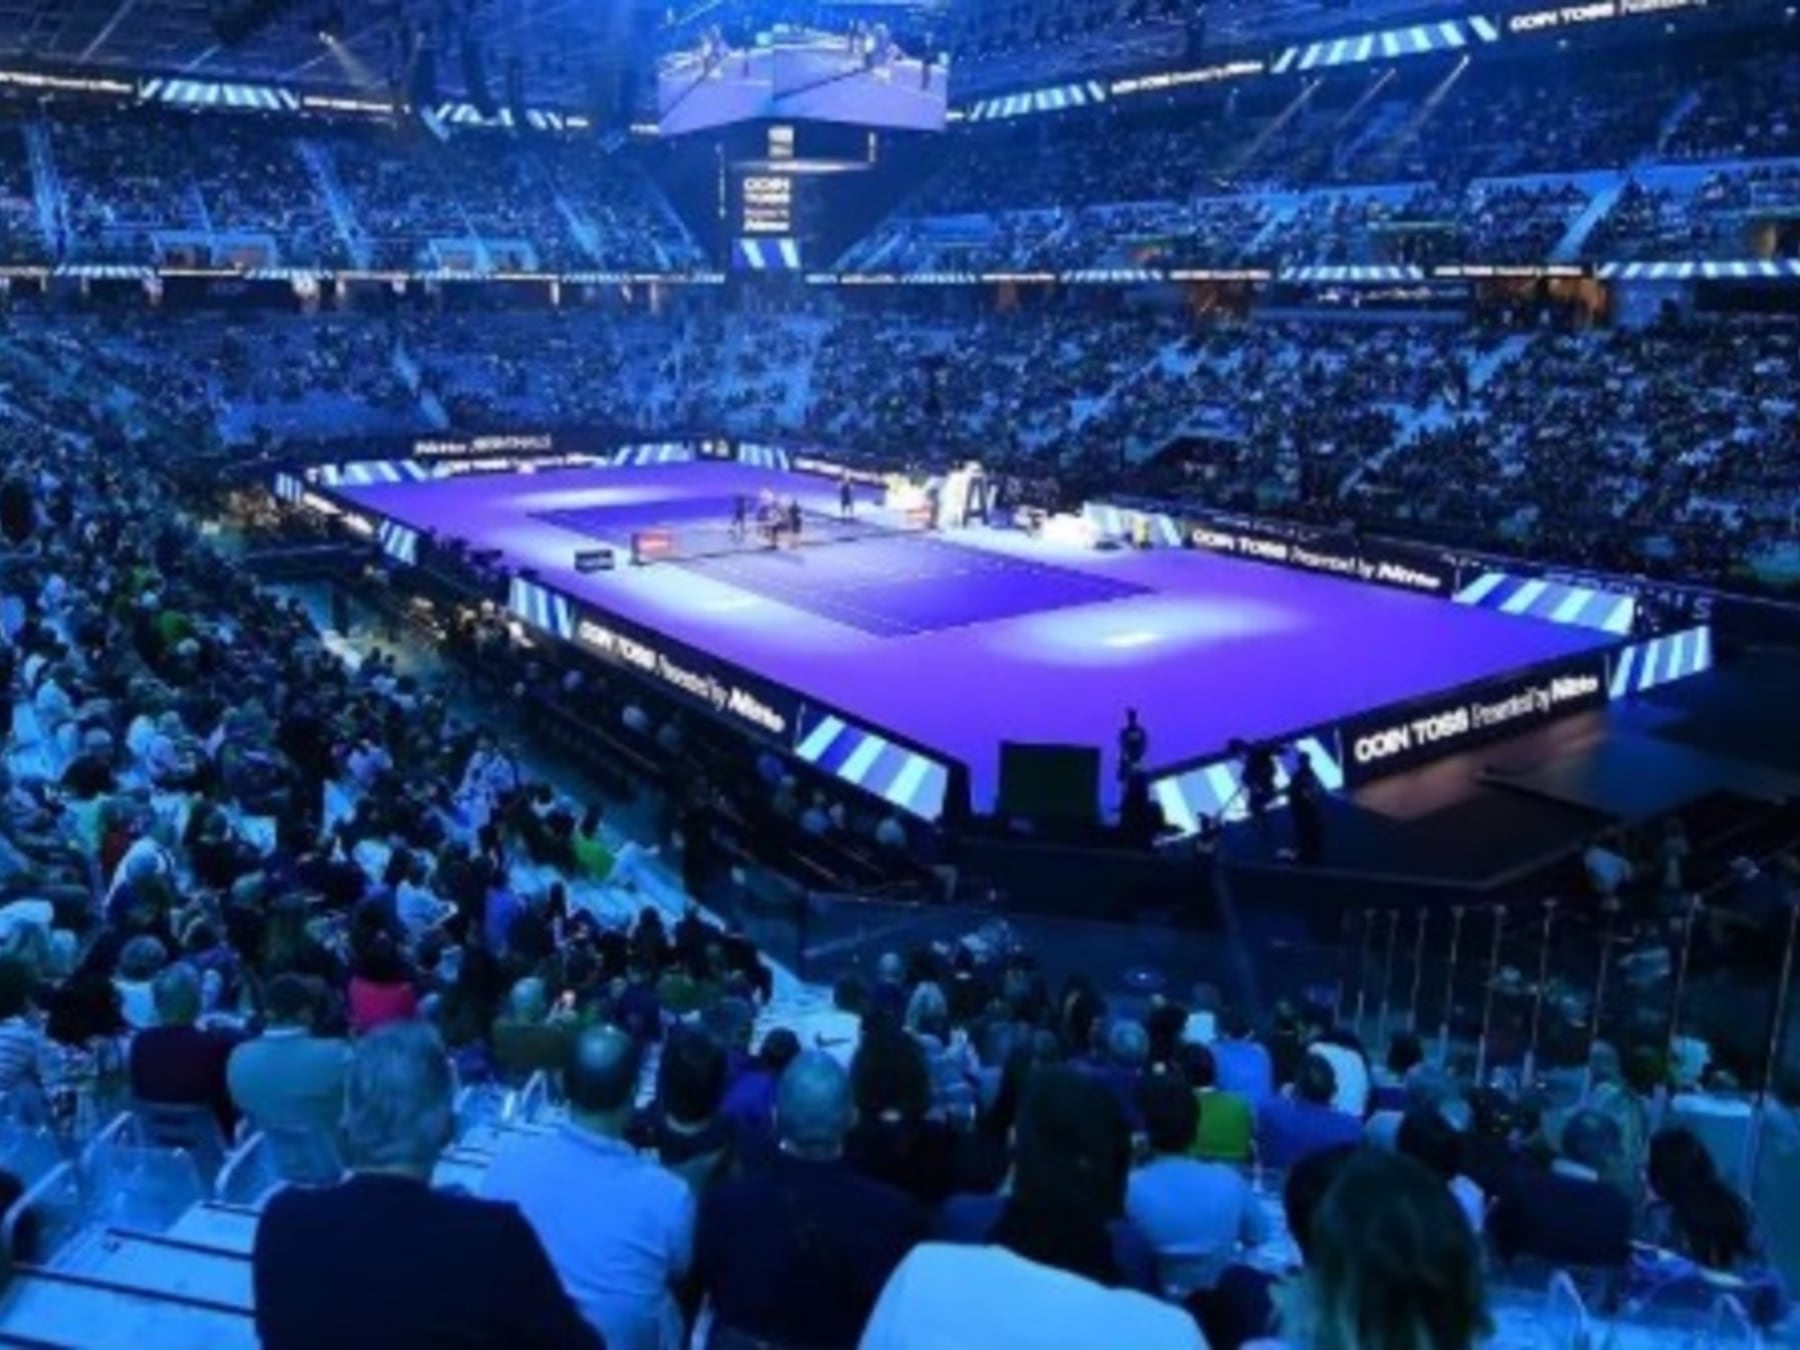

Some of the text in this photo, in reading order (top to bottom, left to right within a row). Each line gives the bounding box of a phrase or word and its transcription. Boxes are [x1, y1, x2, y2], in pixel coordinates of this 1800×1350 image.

[1192, 528, 1235, 550] COIN
[1239, 536, 1287, 560] TOSS
[1355, 726, 1410, 761] COIN
[1412, 706, 1468, 744] TOSS
